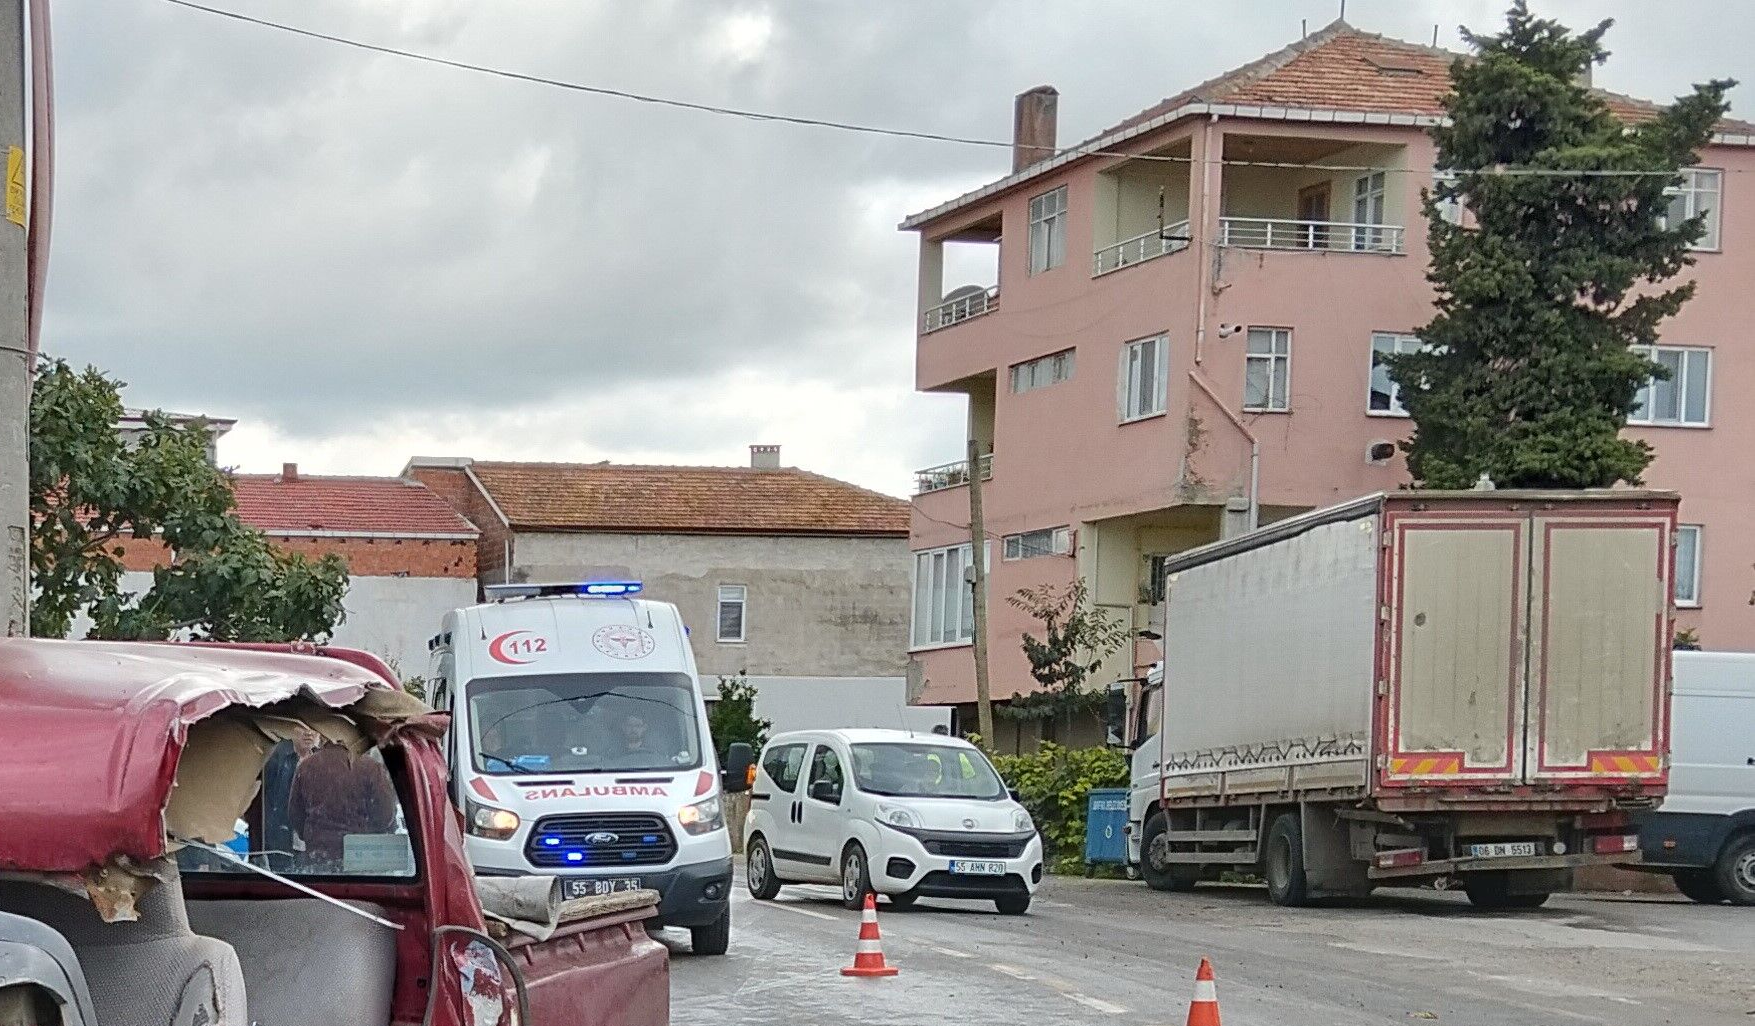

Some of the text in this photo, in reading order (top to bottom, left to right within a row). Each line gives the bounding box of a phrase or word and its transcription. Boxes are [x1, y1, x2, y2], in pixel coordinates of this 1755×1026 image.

[509, 638, 547, 655] 112
[572, 881, 587, 895] 55
[624, 879, 638, 892] 35
